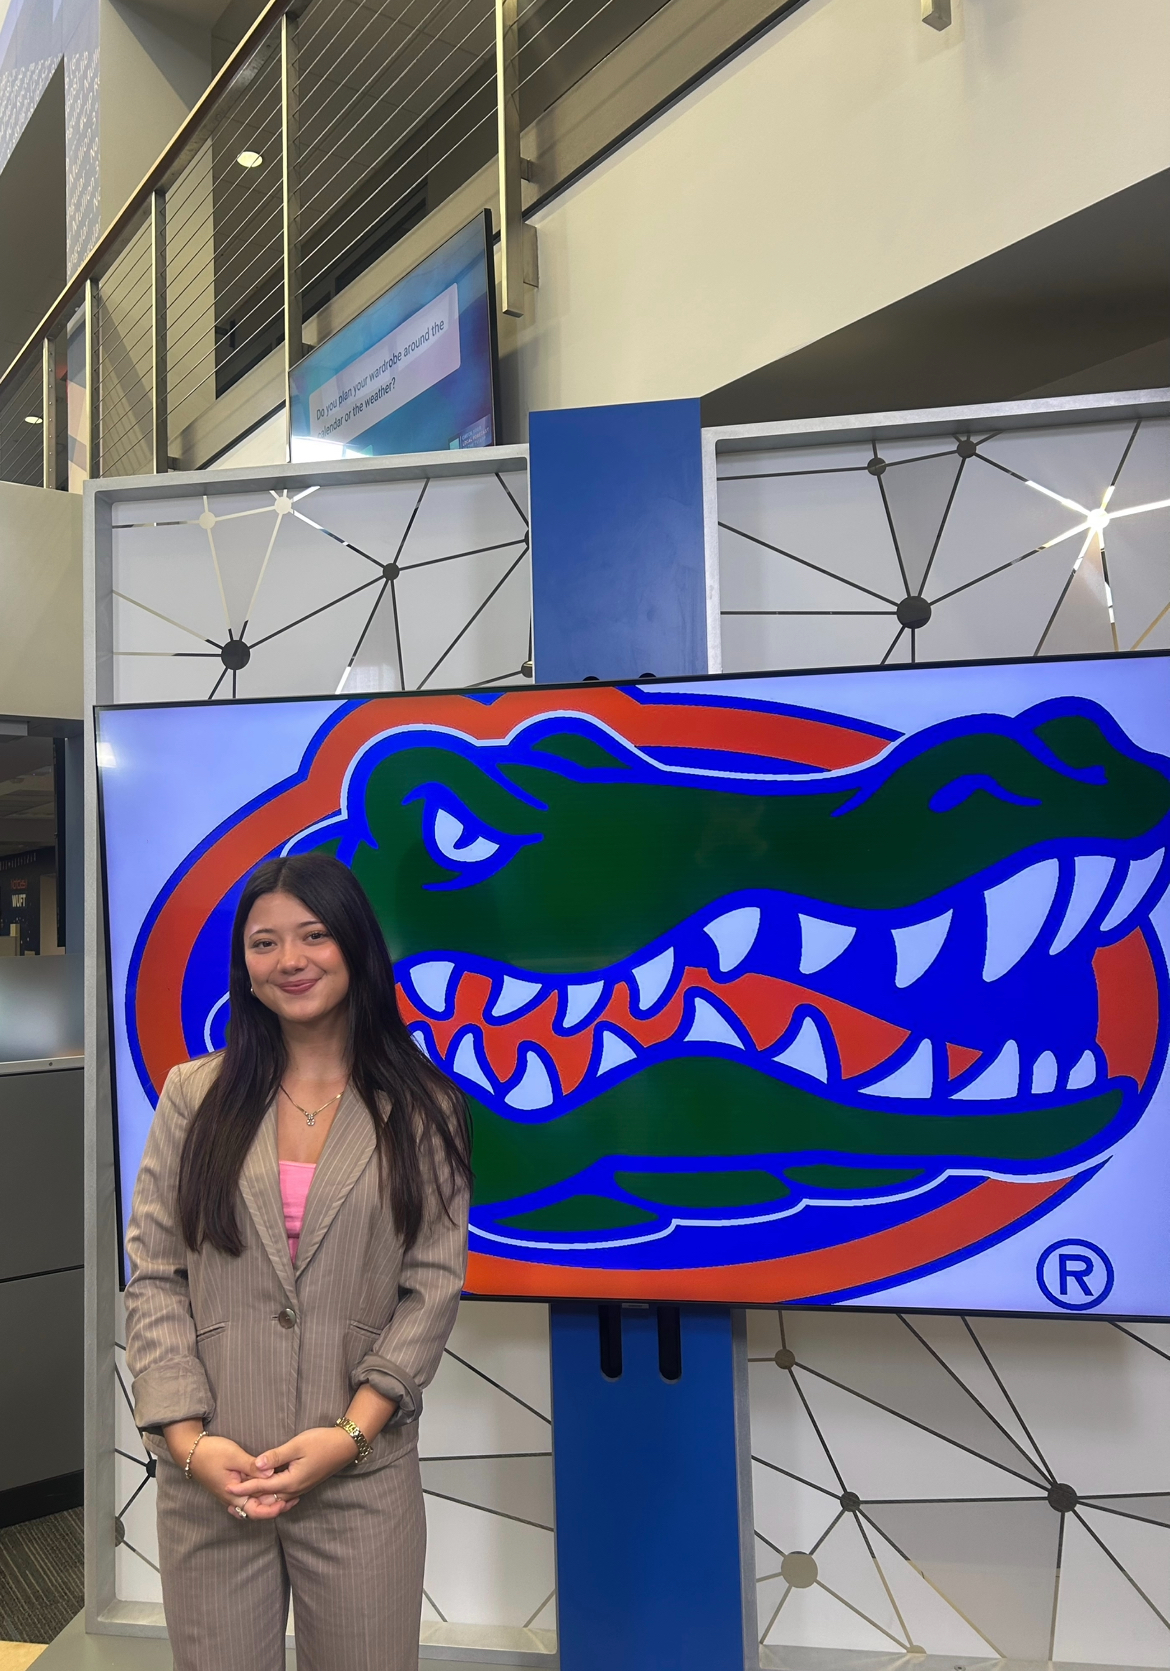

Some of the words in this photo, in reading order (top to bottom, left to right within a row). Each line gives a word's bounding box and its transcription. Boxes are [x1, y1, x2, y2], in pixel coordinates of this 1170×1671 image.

[316, 408, 325, 421] Do
[325, 399, 338, 417] you
[338, 389, 353, 408] plan
[352, 375, 368, 397] your
[368, 351, 402, 382] wardrobe
[403, 327, 430, 357] around
[431, 320, 445, 337] the
[344, 410, 352, 423] or
[352, 402, 364, 417] the
[364, 376, 396, 409] weather?
